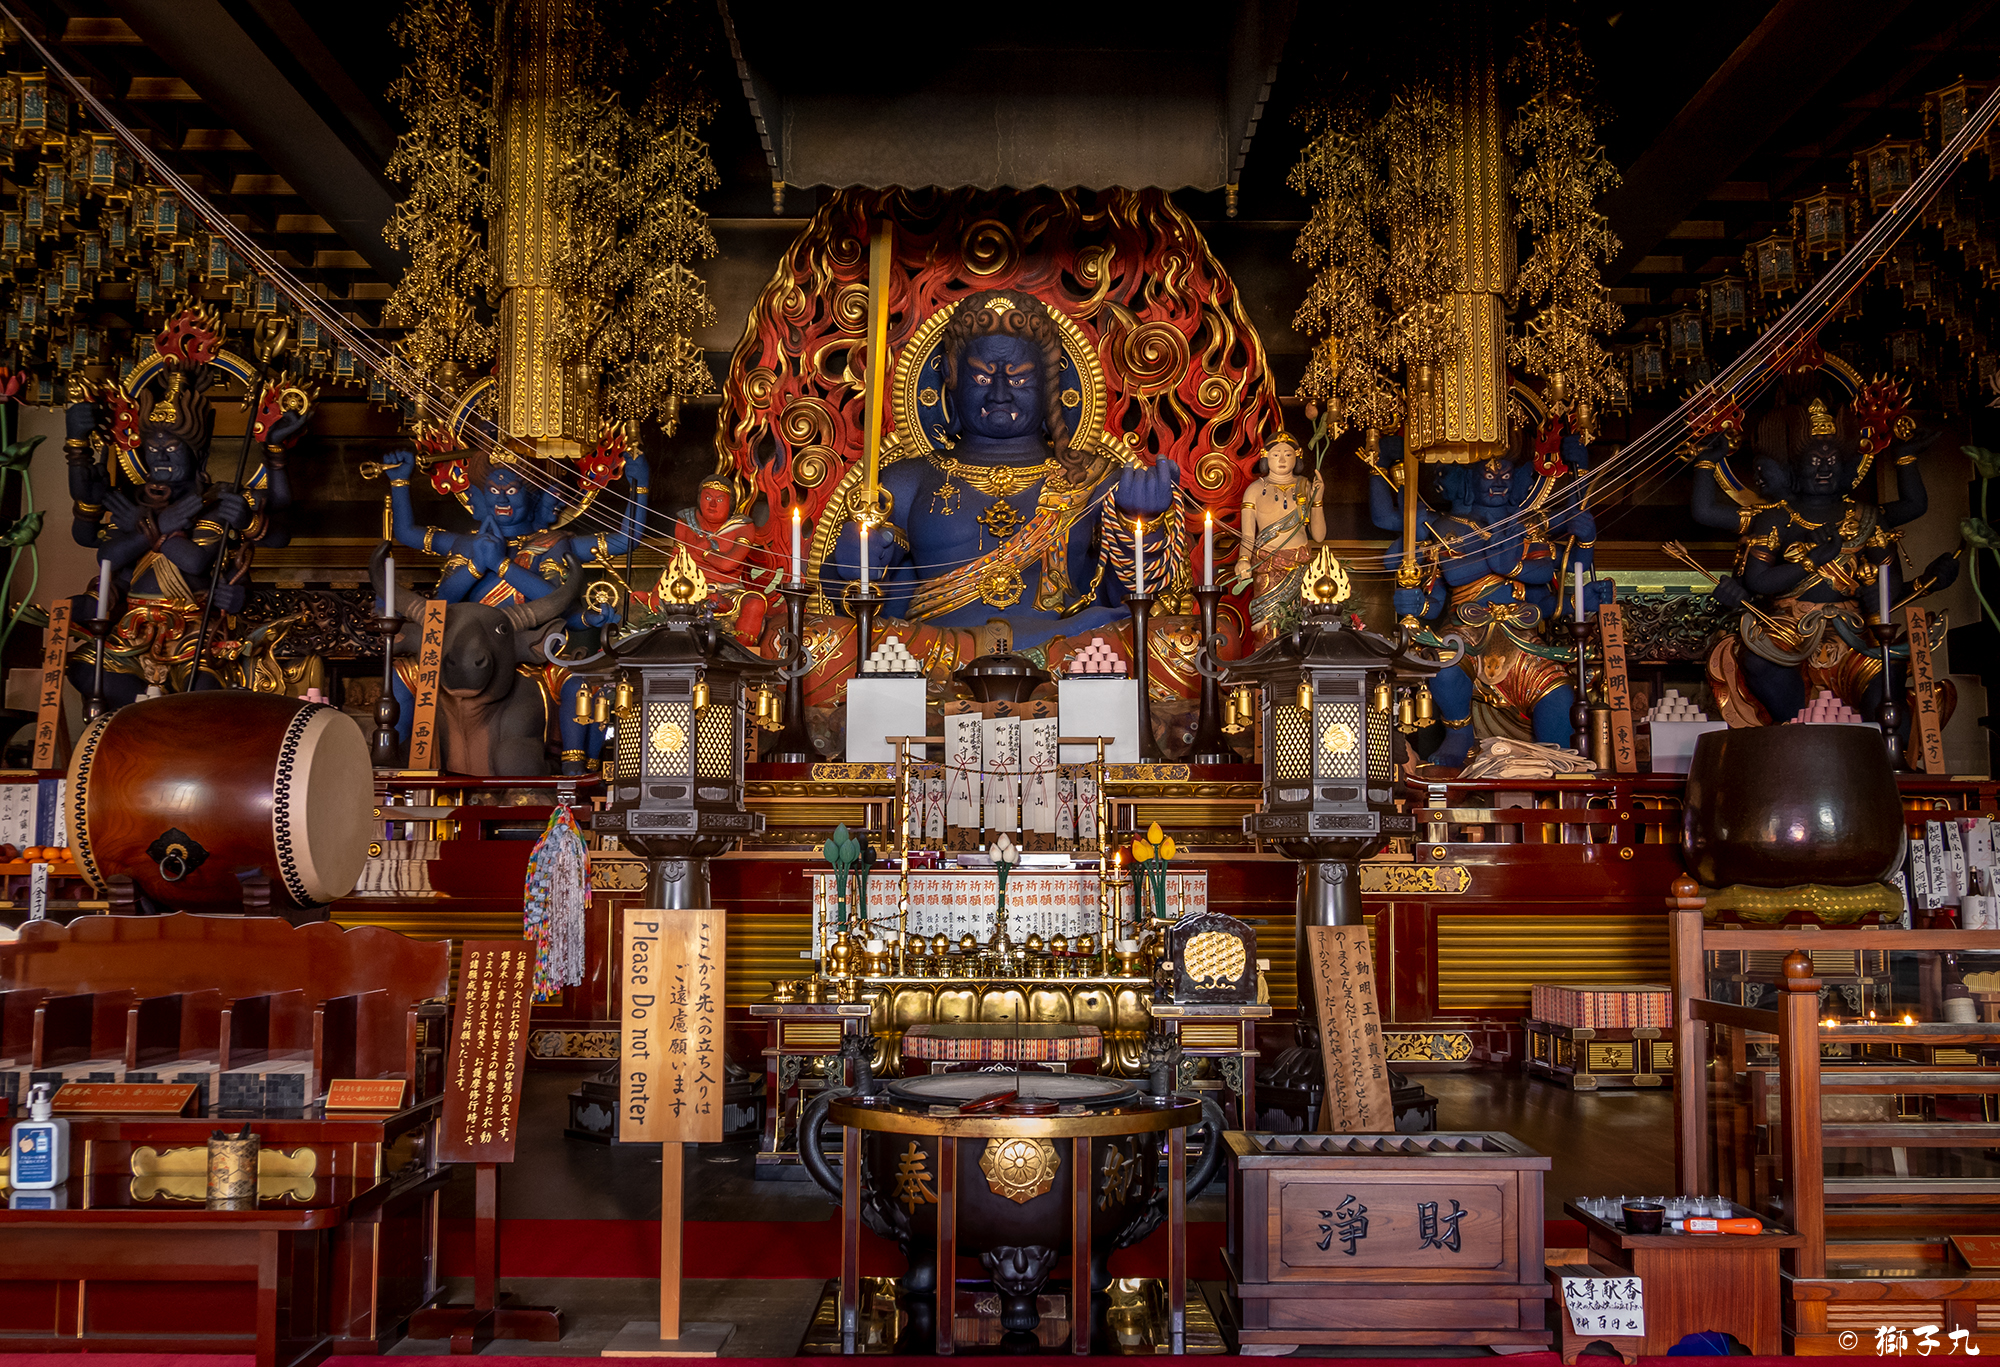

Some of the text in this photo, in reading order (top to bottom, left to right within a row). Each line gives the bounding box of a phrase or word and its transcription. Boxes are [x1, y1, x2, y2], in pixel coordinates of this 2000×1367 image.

[1602, 611, 1630, 713] 降三世明王
[871, 880, 883, 906] 祈願
[885, 880, 897, 906] 祈願
[913, 880, 925, 906] 祈願
[927, 880, 940, 906] 祈願
[941, 880, 954, 906] 祈願
[955, 880, 968, 906] 祈願
[969, 880, 982, 906] 祈願
[983, 880, 996, 906] 祈願
[1012, 881, 1024, 907] 祈願
[1025, 880, 1038, 906] 祈願
[1040, 880, 1052, 906] 祈願
[1054, 880, 1066, 906] 祈願
[1068, 880, 1081, 906] 祈願
[1083, 880, 1095, 906] 祈願
[1193, 880, 1206, 906] 祈願
[694, 923, 716, 1116] ここから先への立ち入りは
[1353, 940, 1383, 1080] 不動明王御真言
[629, 921, 659, 1126] Please Do not enter
[668, 963, 690, 1119] ご遠慮願います
[892, 1140, 939, 1215] 奉
[1565, 1278, 1642, 1300] 本尊献香
